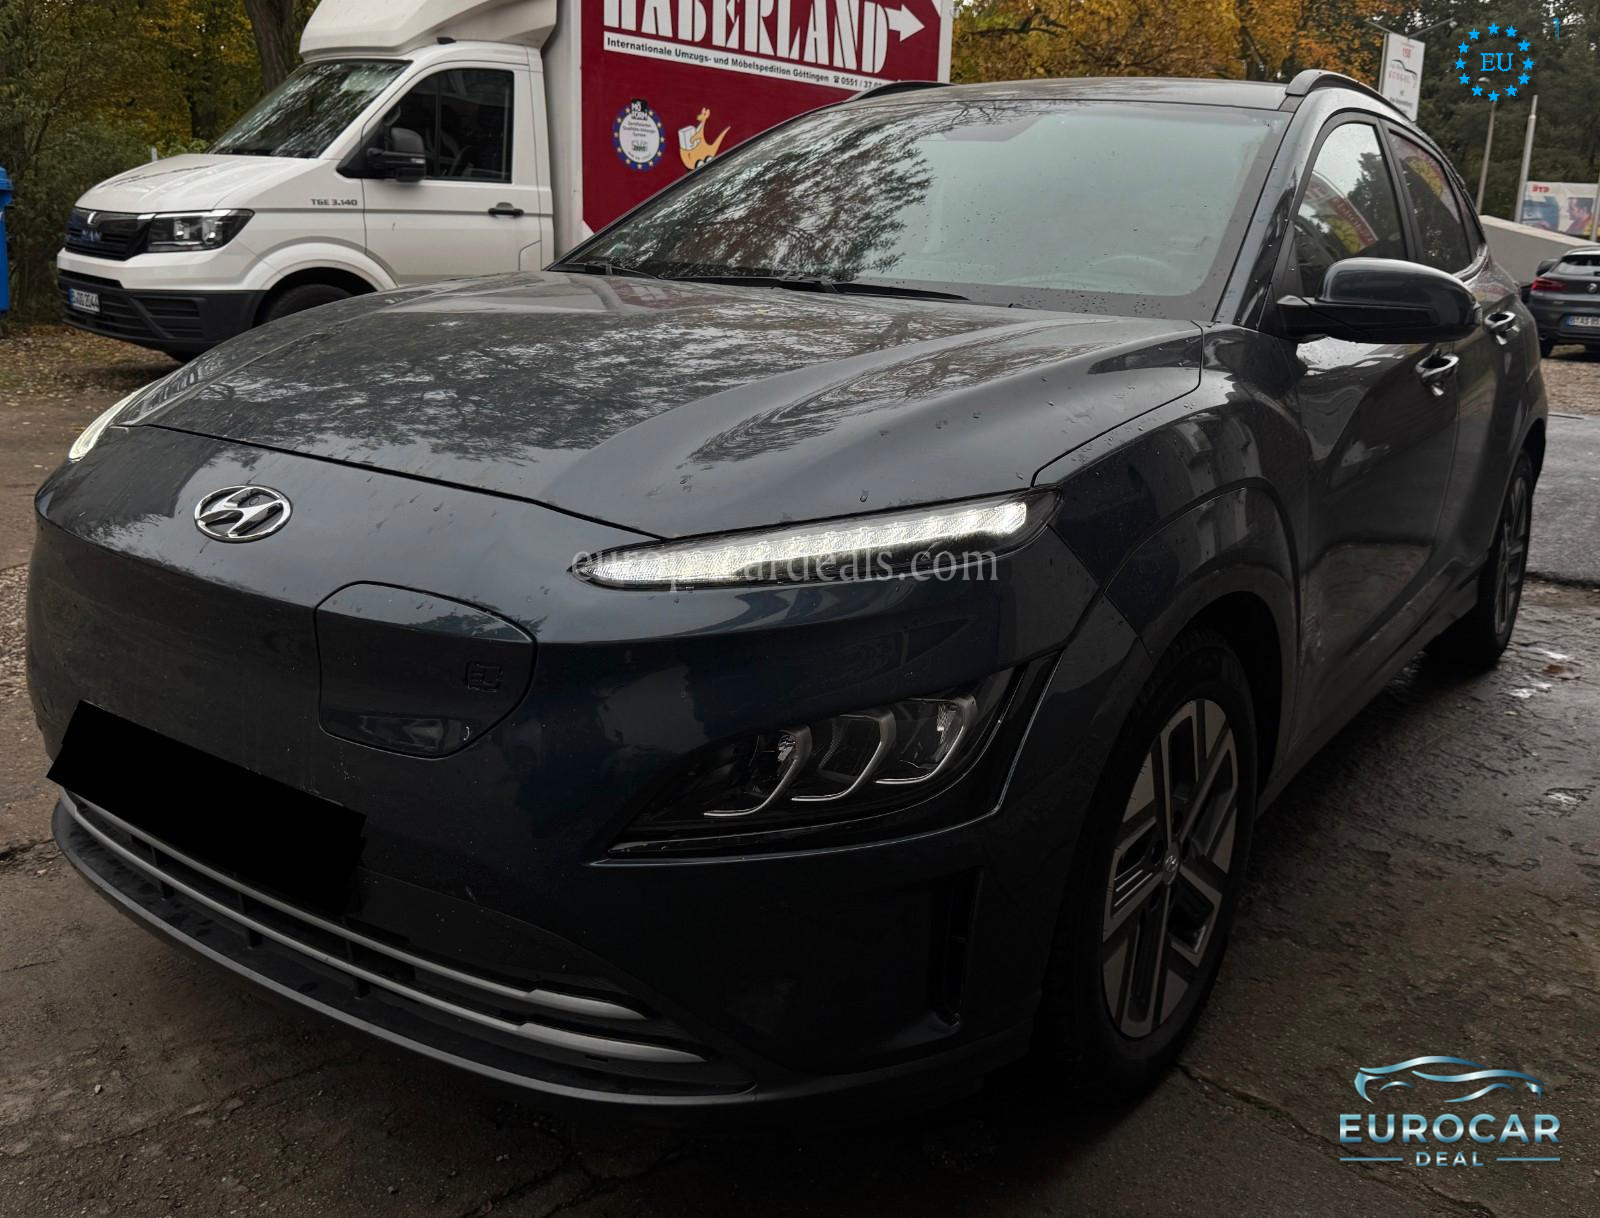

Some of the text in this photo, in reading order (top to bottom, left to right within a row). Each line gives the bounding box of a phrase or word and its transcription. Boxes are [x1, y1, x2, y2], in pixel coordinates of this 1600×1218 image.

[607, 39, 672, 56] Internationale
[675, 48, 711, 63] Umzugs-
[714, 57, 729, 66] und
